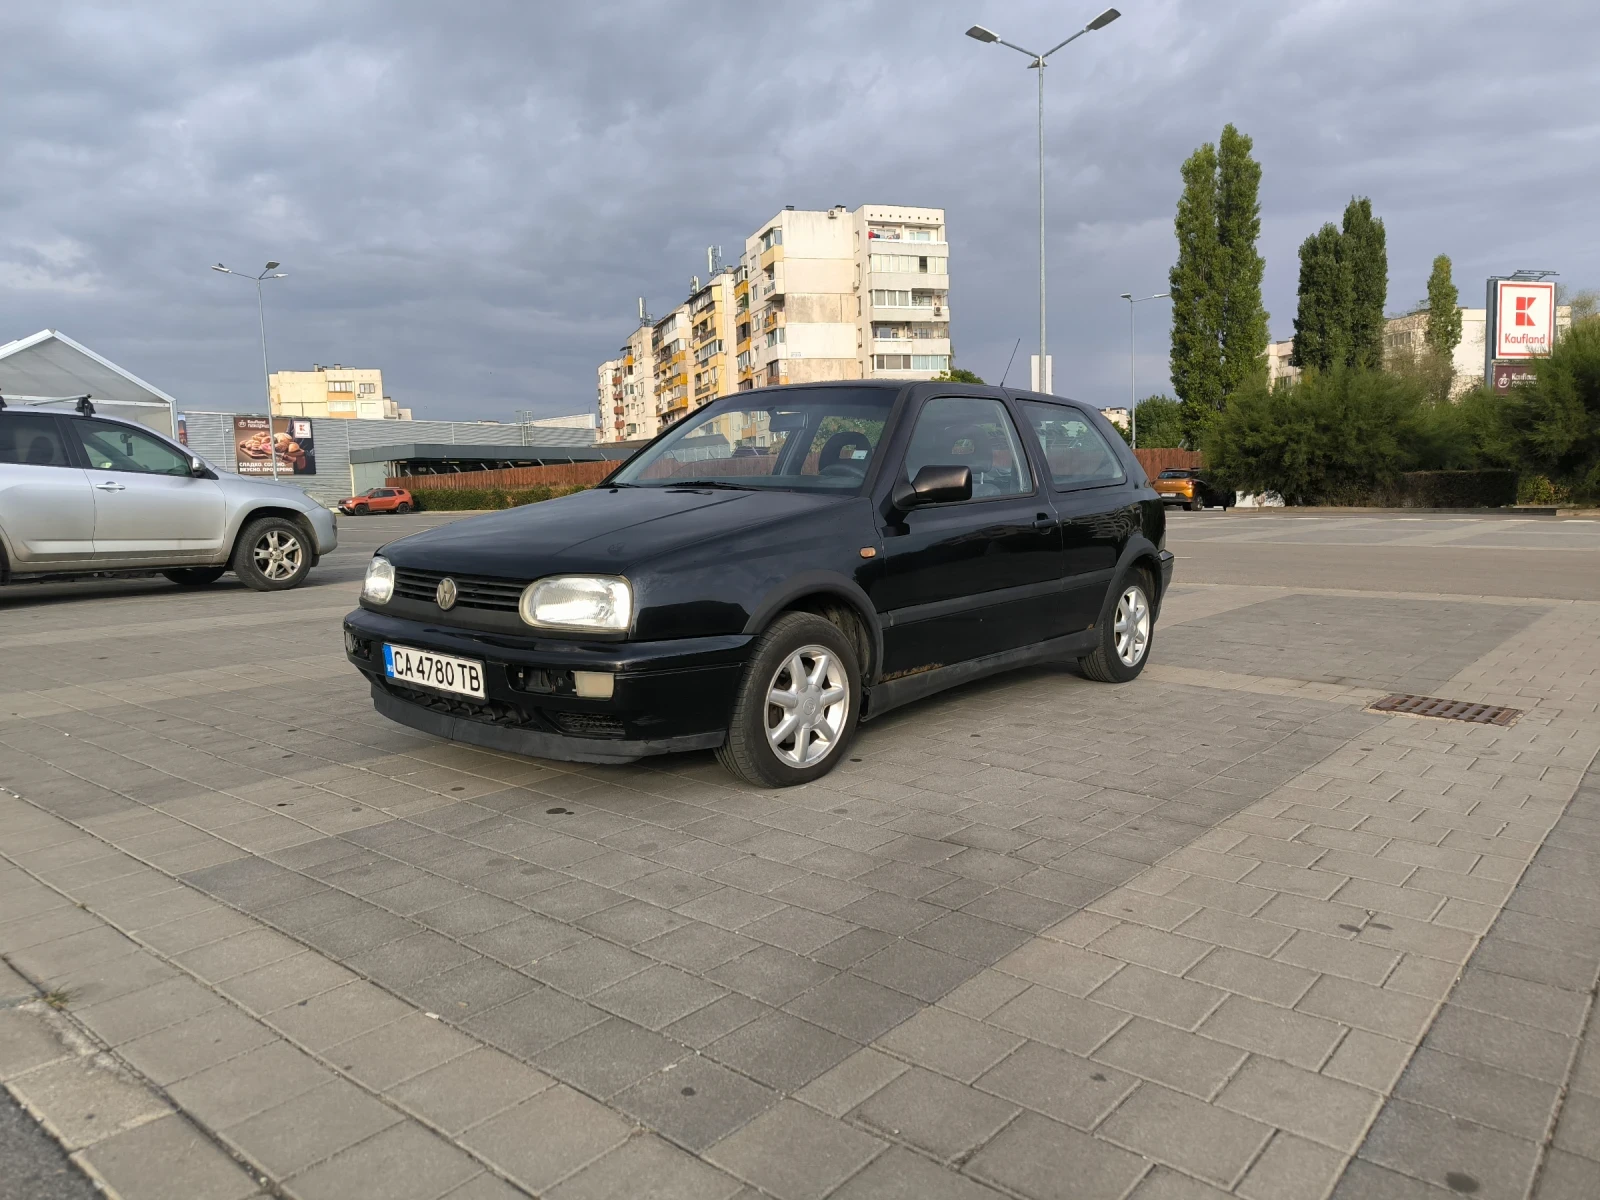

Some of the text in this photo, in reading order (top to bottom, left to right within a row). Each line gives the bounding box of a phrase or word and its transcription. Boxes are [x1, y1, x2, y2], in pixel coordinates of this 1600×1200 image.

[1505, 333, 1545, 344] Kaufland
[394, 651, 481, 692] CA 4780 TB
